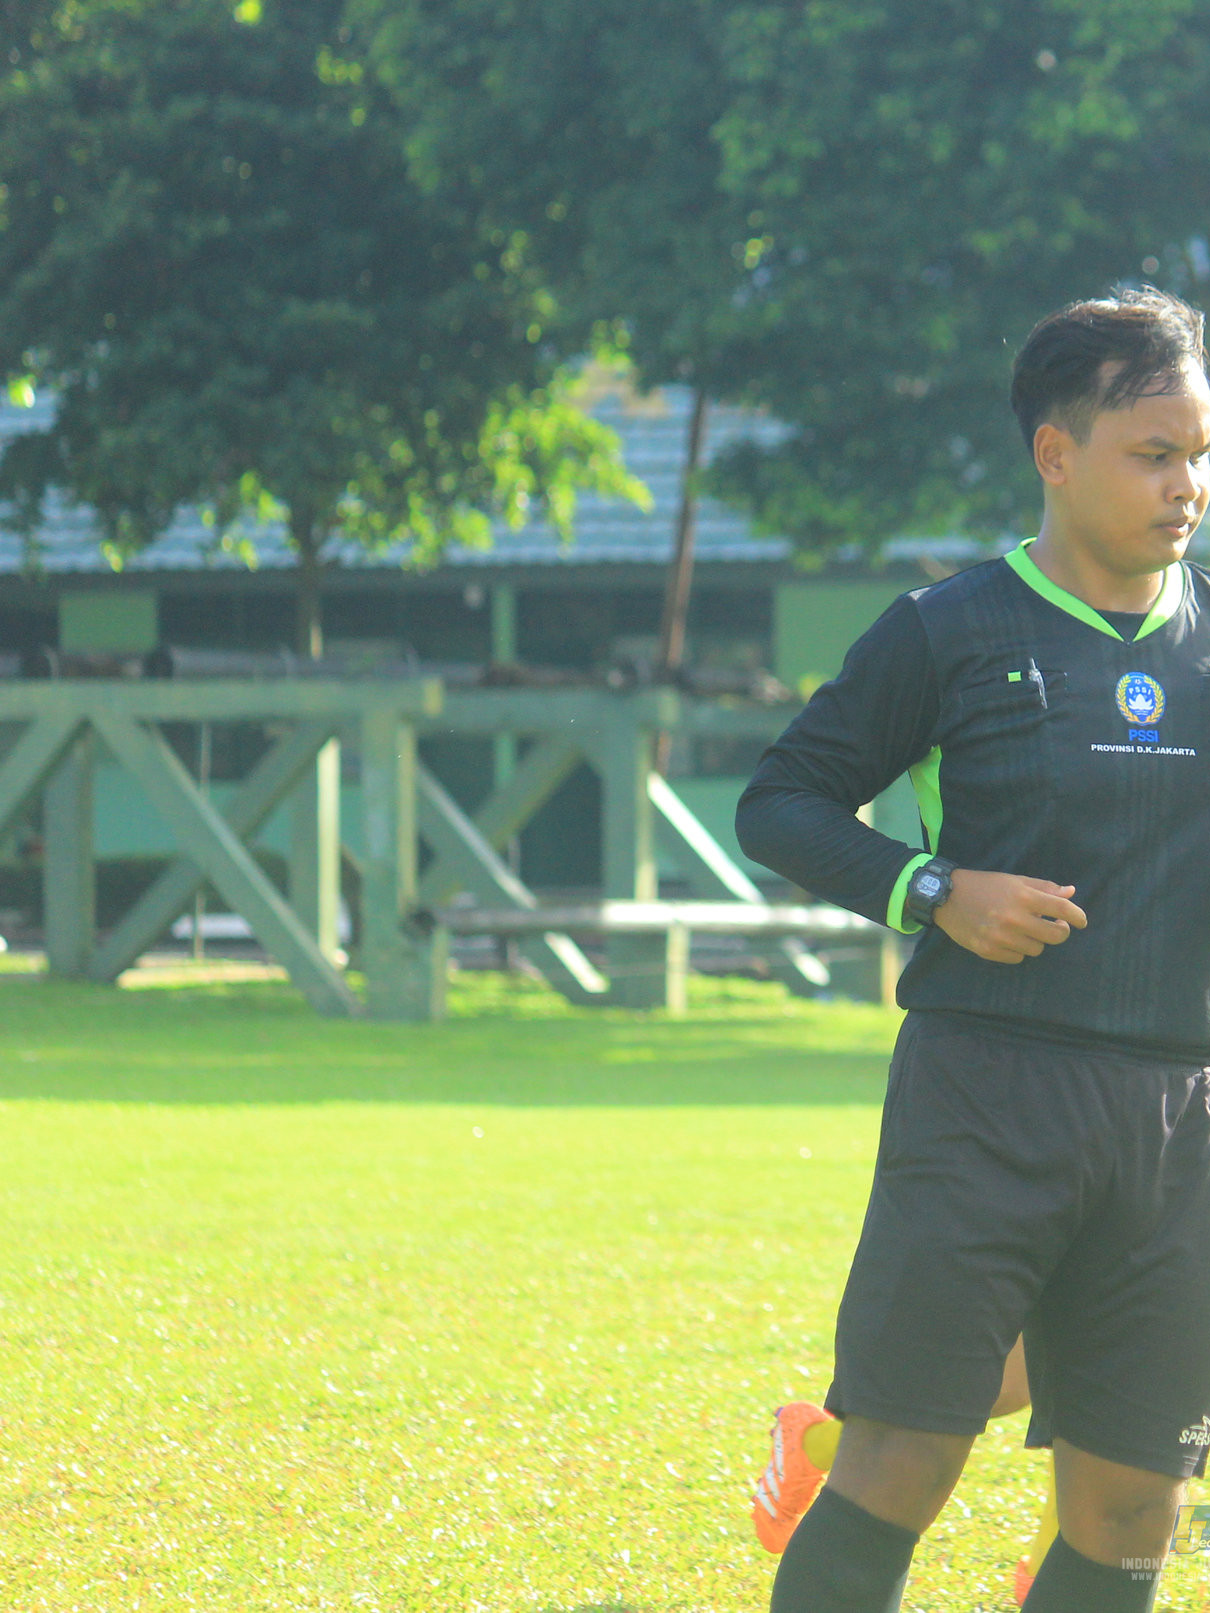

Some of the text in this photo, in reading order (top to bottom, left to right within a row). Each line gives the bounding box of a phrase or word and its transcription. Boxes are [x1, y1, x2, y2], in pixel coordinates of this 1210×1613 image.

[1128, 686, 1151, 695] PSSI
[1128, 729, 1159, 743] PSSI
[1090, 743, 1196, 757] PROVINSI D.K.JAKARTA
